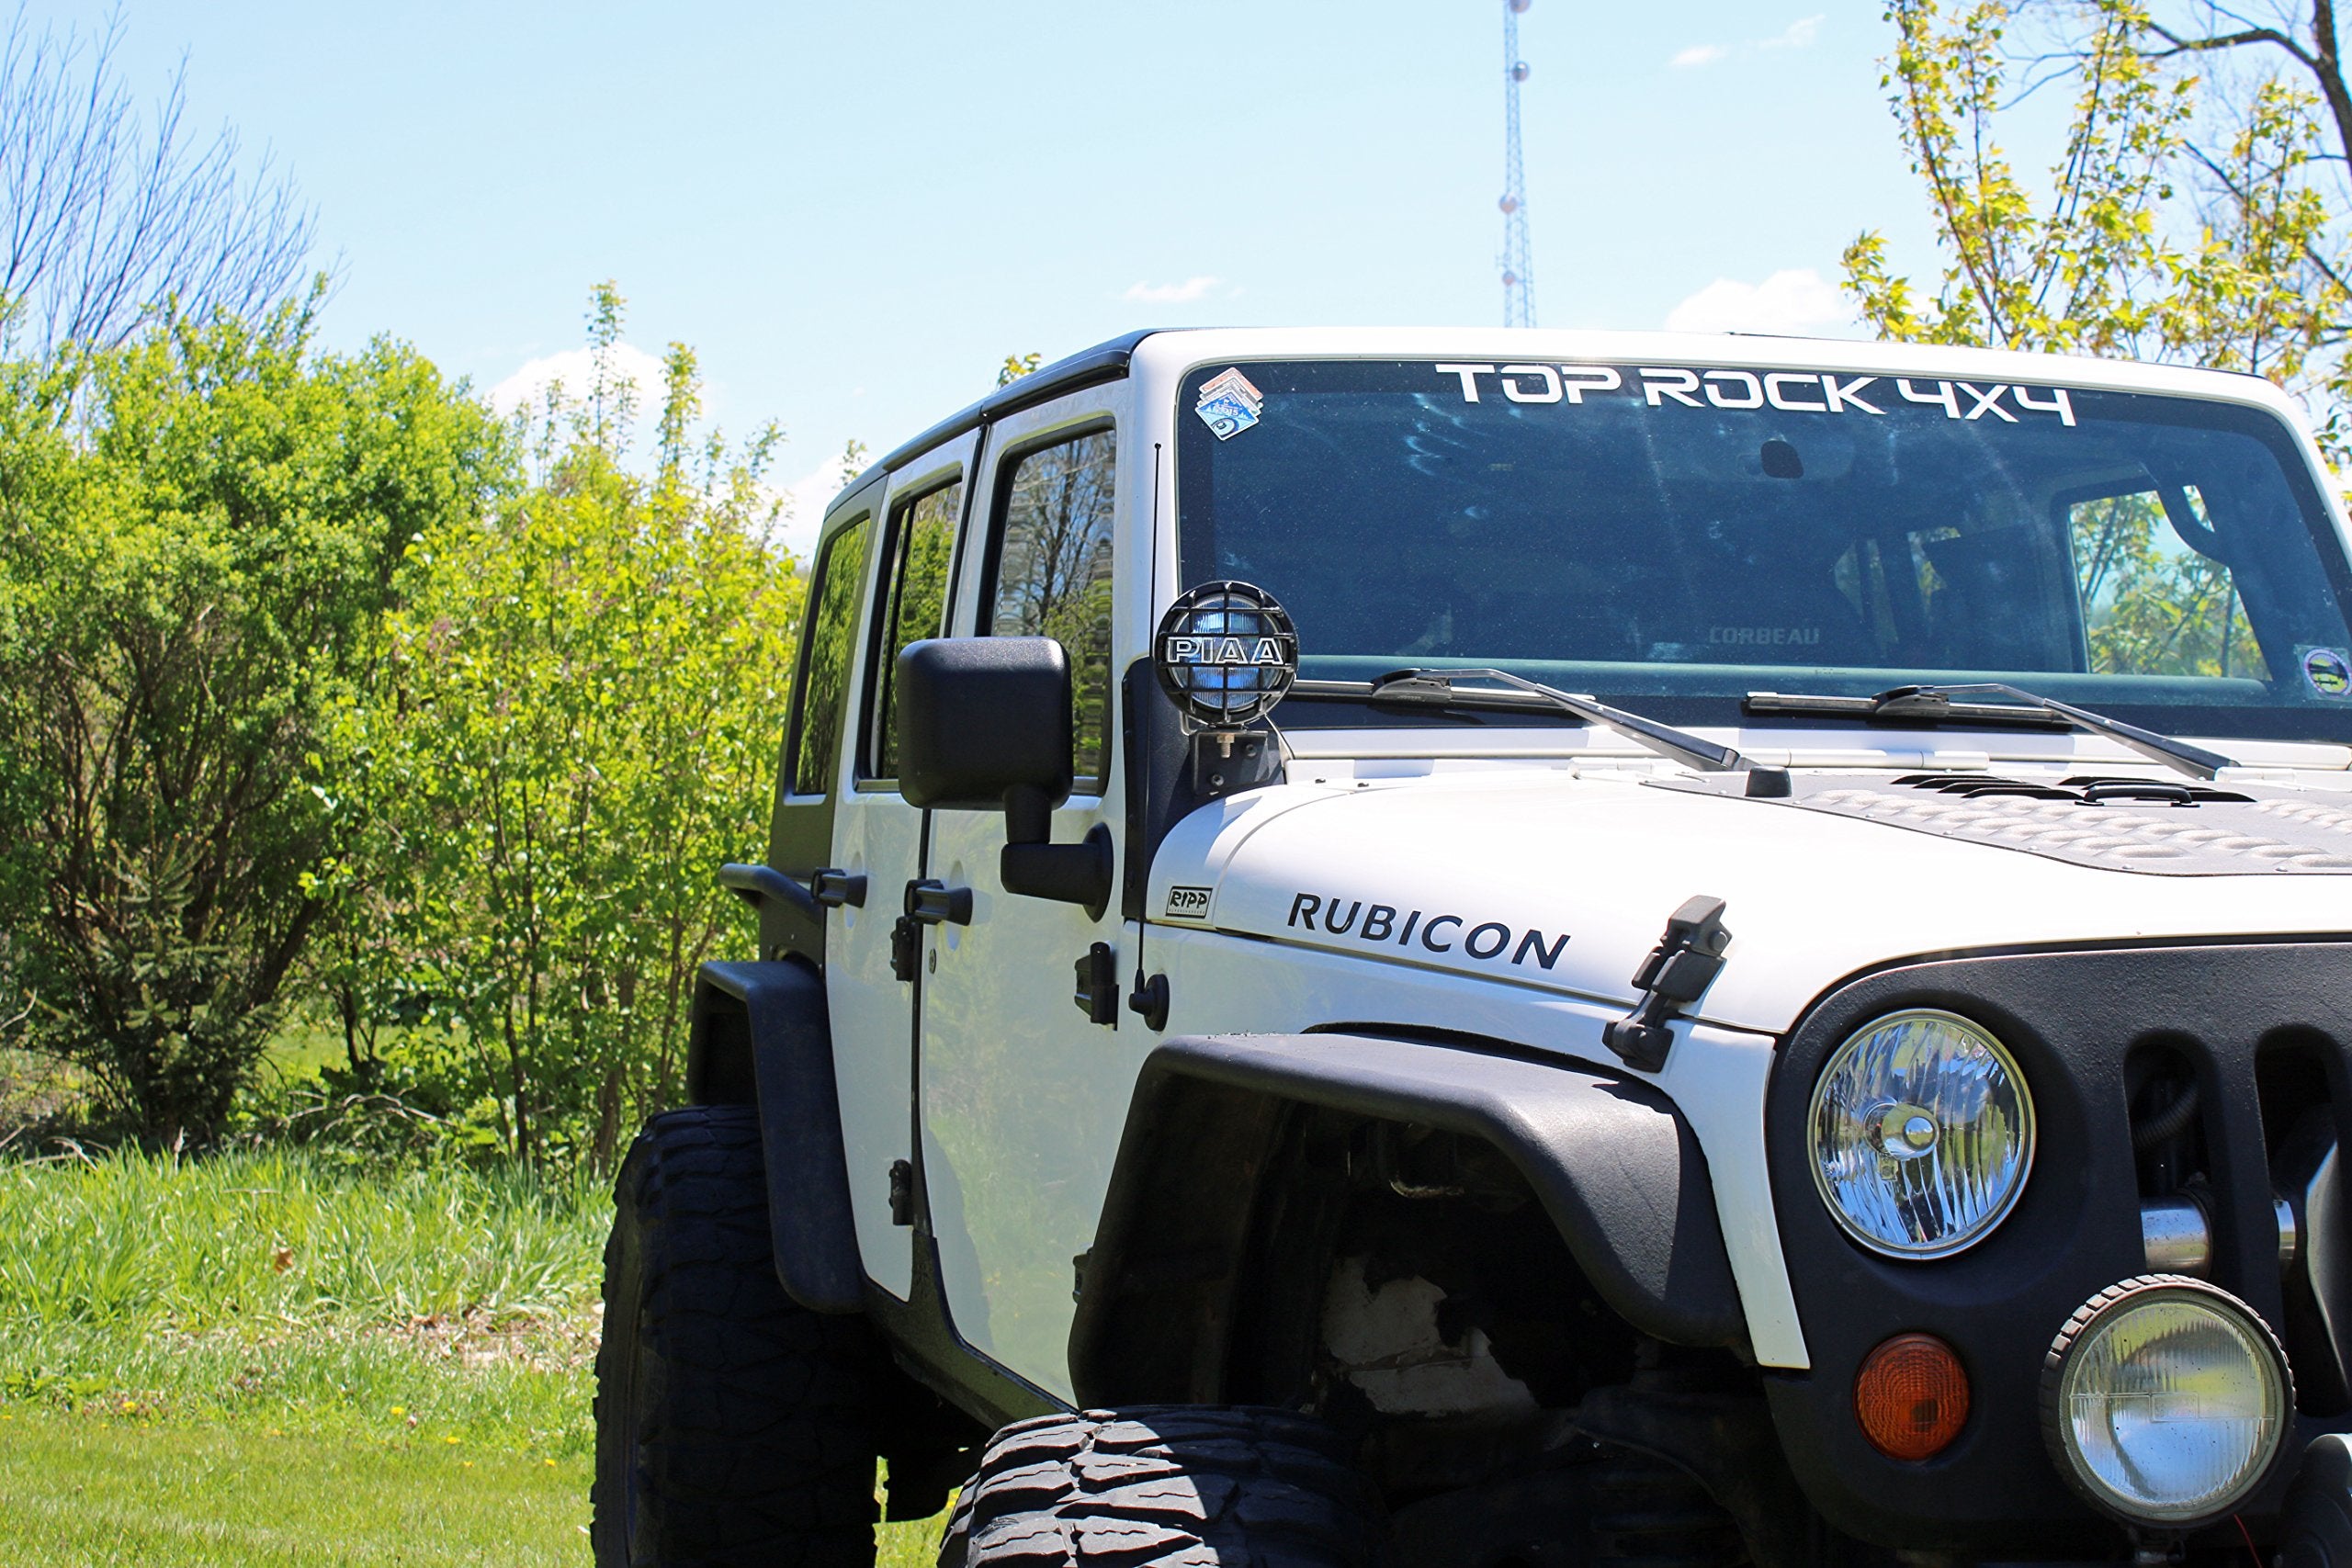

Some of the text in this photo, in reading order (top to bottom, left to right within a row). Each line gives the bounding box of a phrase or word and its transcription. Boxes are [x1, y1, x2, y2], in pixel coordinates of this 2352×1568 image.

[1435, 364, 1623, 404] TOP
[1639, 368, 1887, 414] ROCK
[1709, 626, 1820, 644] CORBEAU
[1167, 636, 1284, 665] PIAA
[1170, 890, 1208, 908] RIPP
[1287, 893, 1571, 970] RUBICON
